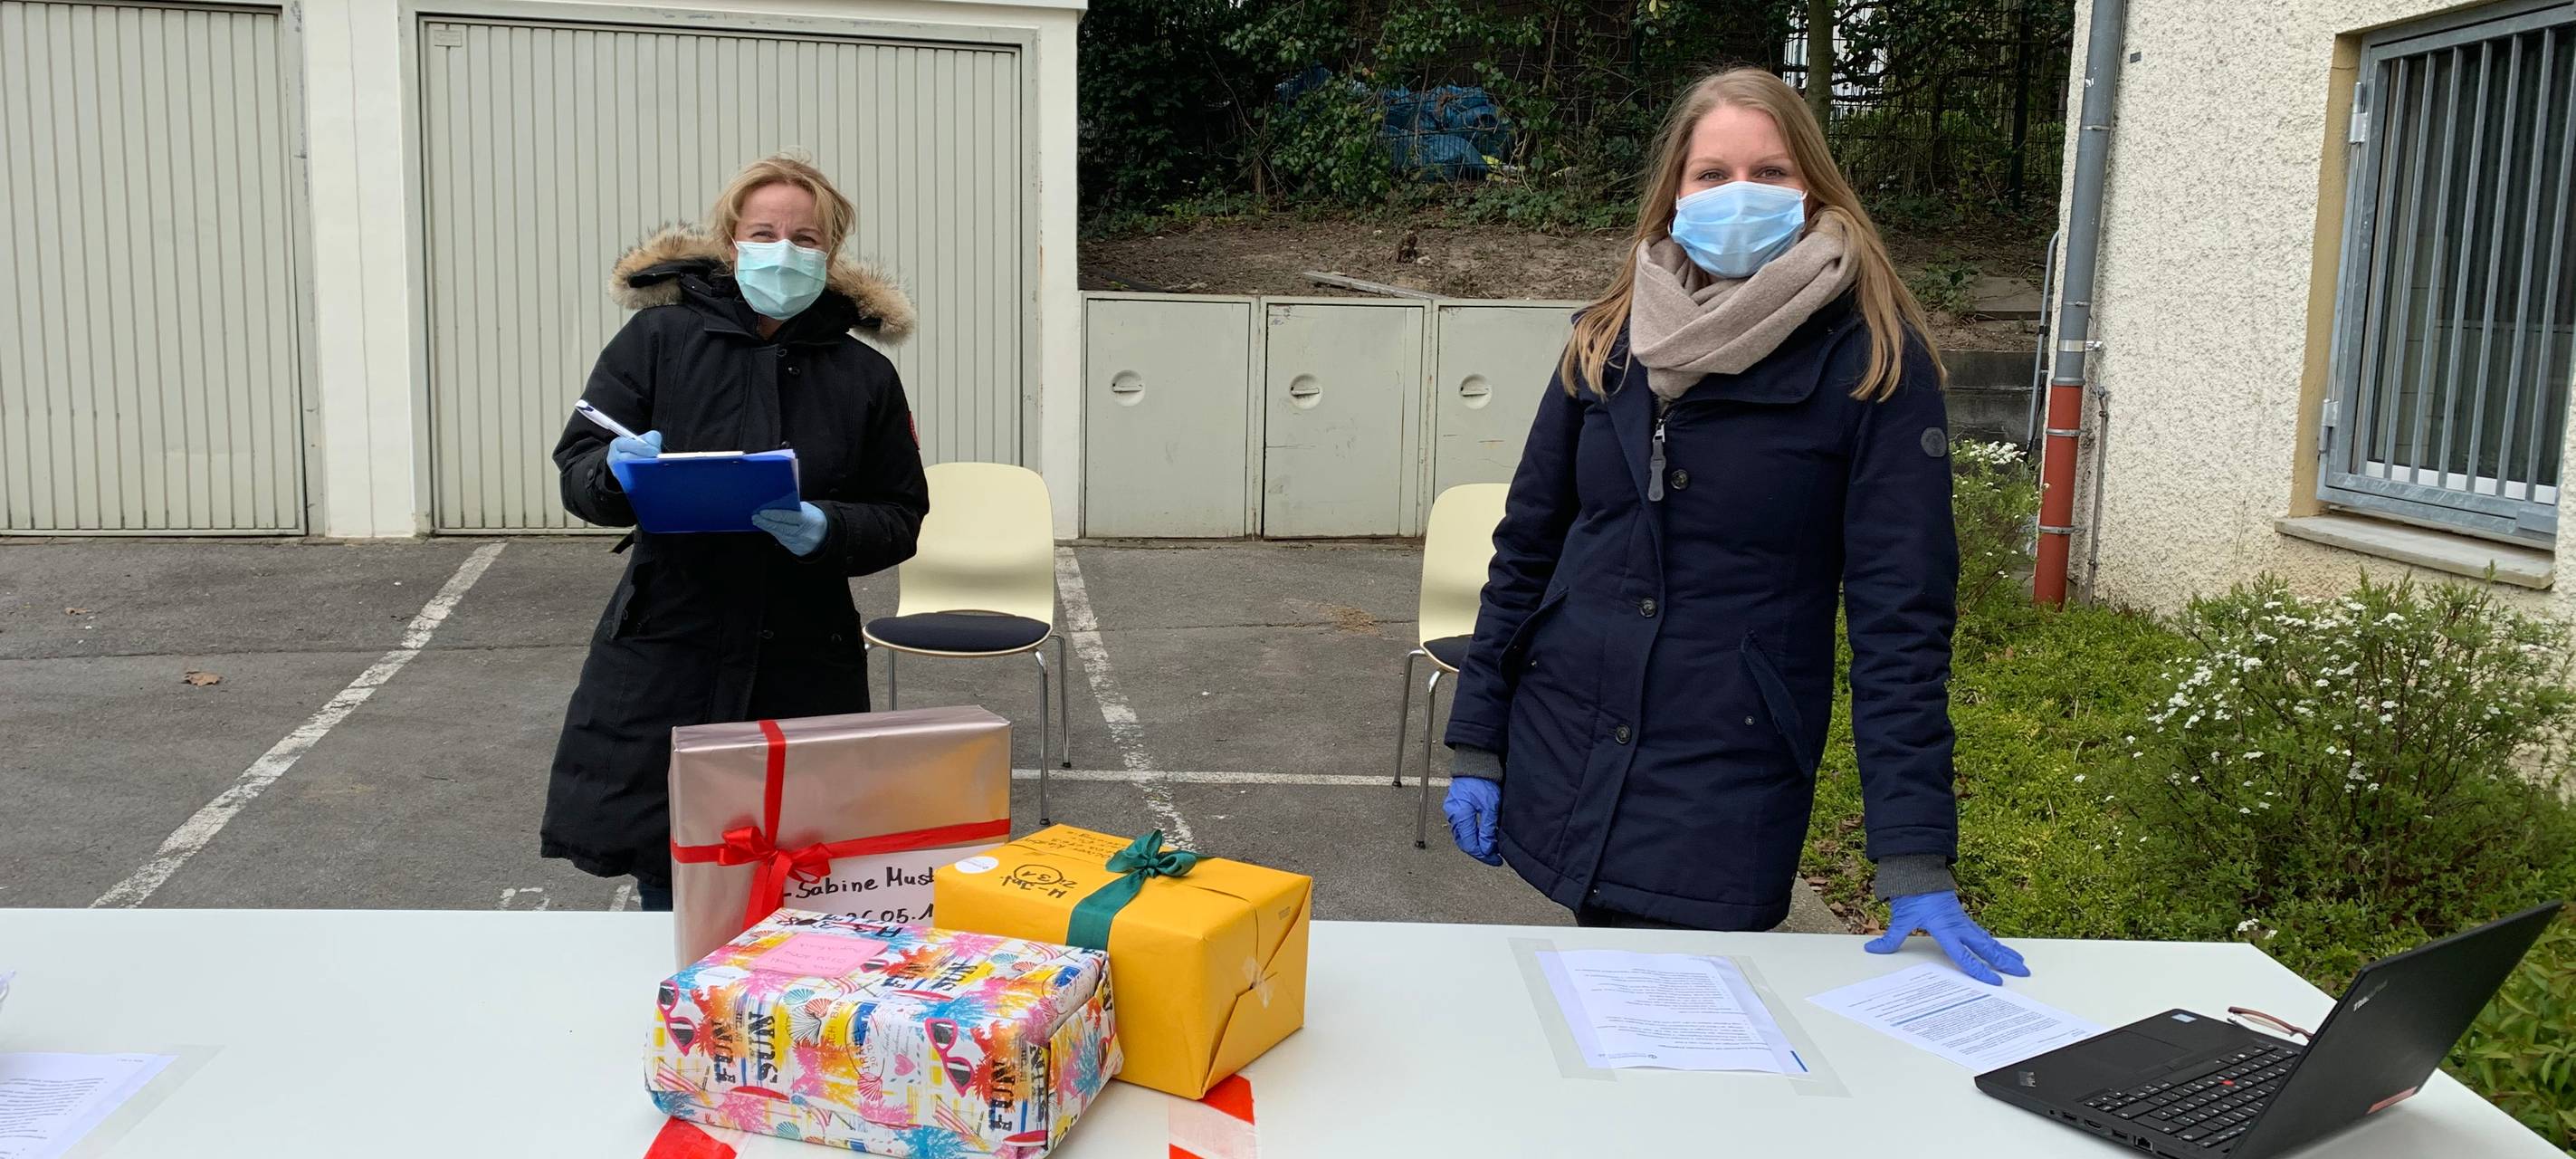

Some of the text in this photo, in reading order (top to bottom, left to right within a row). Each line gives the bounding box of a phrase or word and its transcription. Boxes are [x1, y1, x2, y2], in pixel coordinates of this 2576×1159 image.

[930, 963, 978, 991] SUN
[711, 1019, 736, 1084] FUN
[749, 1011, 778, 1084] SUN
[988, 1059, 1016, 1131] FUN
